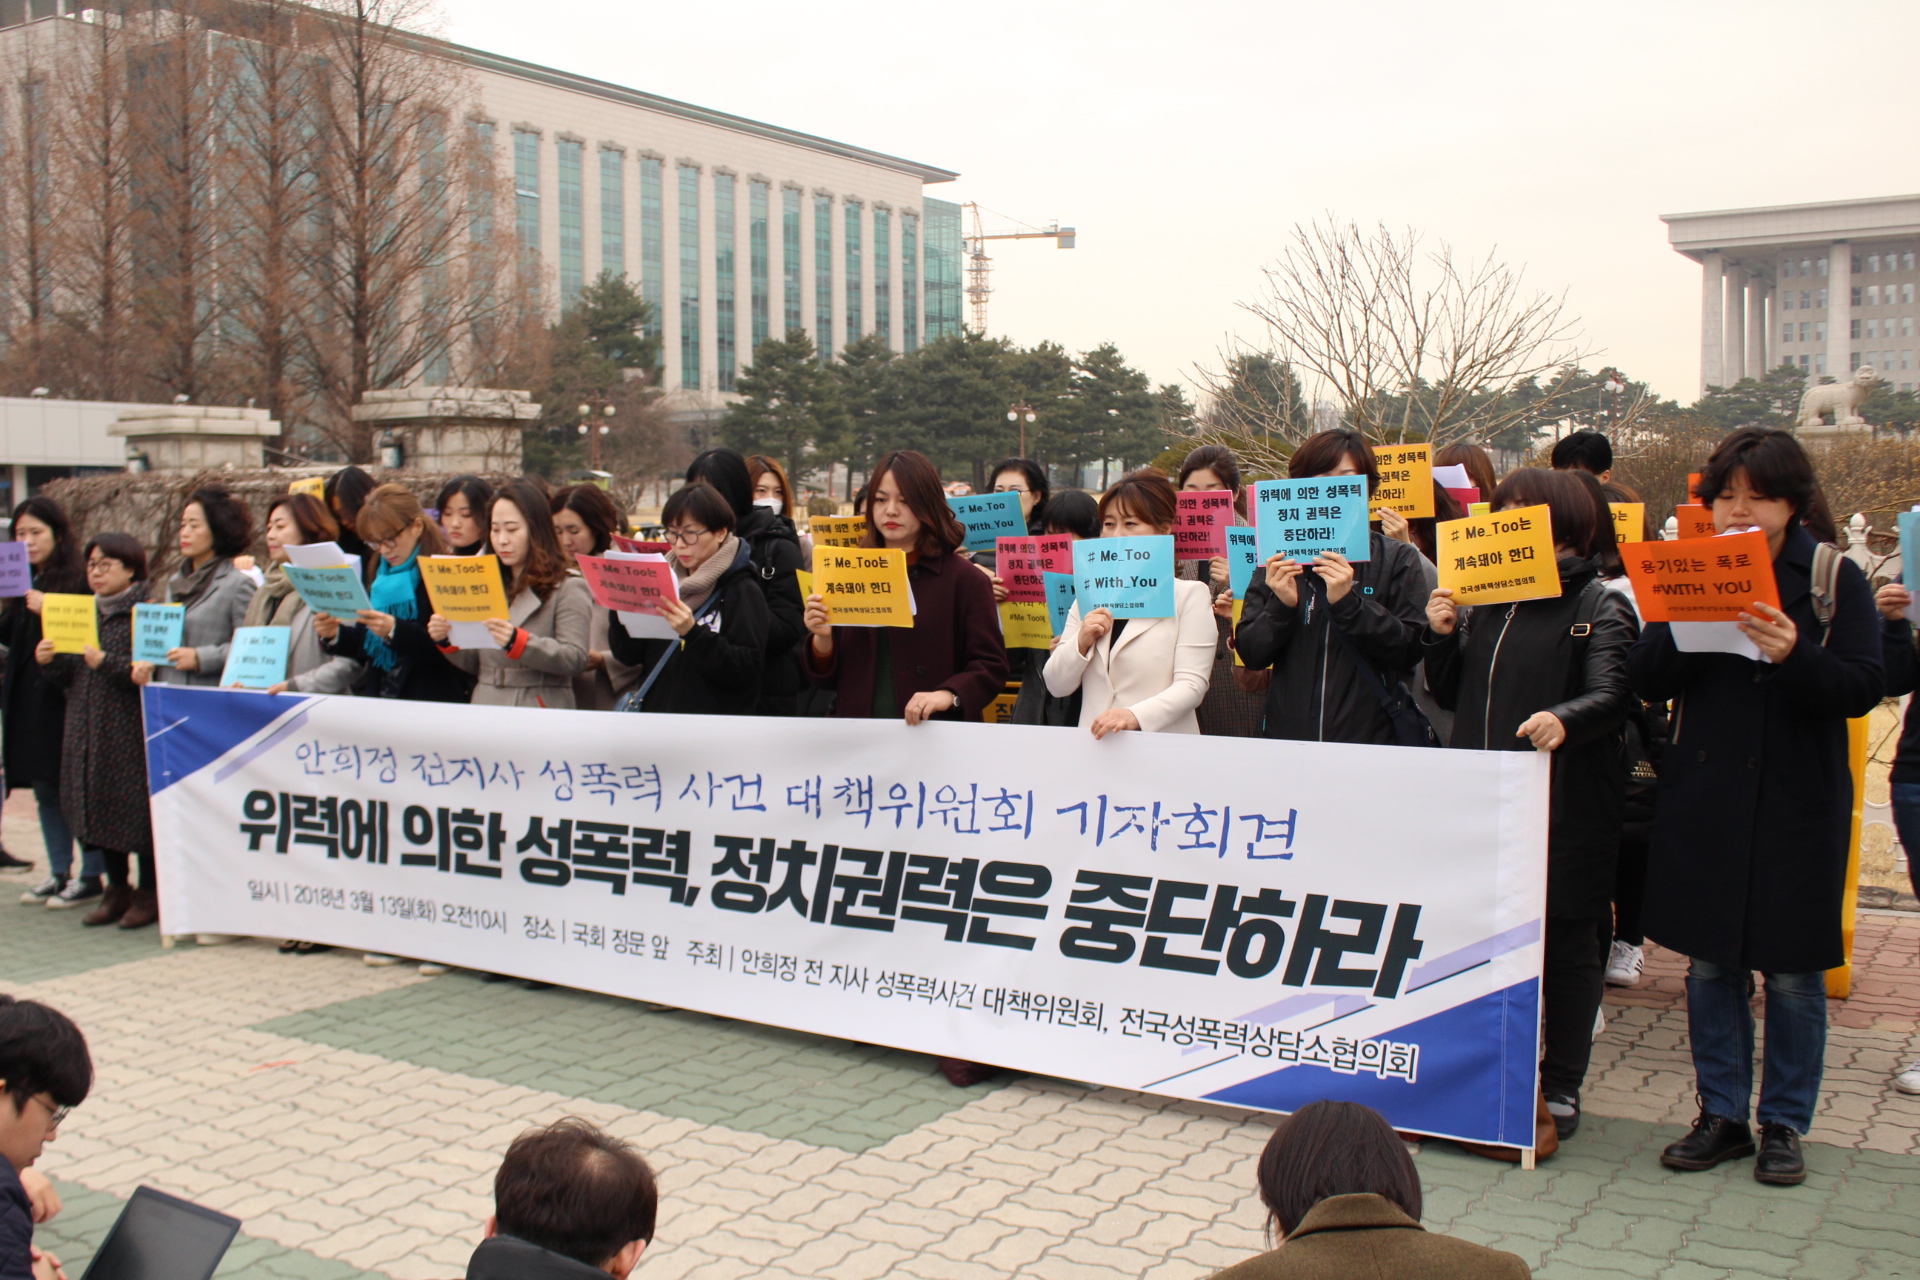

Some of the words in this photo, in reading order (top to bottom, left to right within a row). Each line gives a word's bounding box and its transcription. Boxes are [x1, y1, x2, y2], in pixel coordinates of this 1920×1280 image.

[1397, 451, 1426, 464] 성폭력
[1382, 470, 1410, 483] 권력은
[1260, 488, 1291, 502] 위력에
[1297, 487, 1319, 500] 의한
[1325, 484, 1361, 499] 성폭력
[1369, 488, 1405, 501] 단하라!
[968, 503, 1005, 513] Me_Too
[1179, 499, 1197, 509] 의한
[1202, 498, 1229, 509] 성폭력
[1187, 515, 1214, 526] 권력은
[1277, 508, 1299, 522] 정치
[1306, 506, 1342, 521] 권력은
[835, 523, 849, 533] 의한
[968, 520, 1014, 532] With_You
[1451, 530, 1460, 542] #
[1465, 517, 1531, 540] Me_Too는
[1230, 534, 1255, 546] 위력에
[1284, 527, 1335, 541] 중단하라!
[1040, 541, 1068, 553] 성폭력
[824, 557, 830, 567] #
[835, 556, 888, 568] Me_Too는
[1088, 551, 1095, 563] #
[1100, 549, 1150, 562] Me_Too
[1245, 552, 1257, 564] 정
[1454, 551, 1502, 571] 계속돼야
[1508, 546, 1534, 562] 한다
[1641, 558, 1706, 574] 용기있는
[1717, 554, 1752, 569] 폭로
[603, 564, 657, 578] Me_Too는
[826, 582, 865, 594] 계속돼야
[871, 582, 891, 594] 한다
[1084, 579, 1090, 590] #
[1095, 576, 1157, 589] With_You
[1460, 576, 1536, 594] 전국성폭력상담소협의회
[1652, 582, 1704, 596] #WITH
[1713, 580, 1752, 595] YOU
[641, 585, 661, 597] 한다
[295, 740, 397, 783] 안희정
[539, 760, 662, 813] 성폭력
[679, 771, 766, 812] 사건
[1056, 794, 1297, 860] 기자회견
[240, 790, 388, 864] 위력에
[401, 805, 506, 879] 의한
[516, 816, 701, 907] 성폭력,
[710, 835, 1052, 951] 정치권력은
[1059, 870, 1424, 999] 중단하라
[248, 880, 280, 903] 일시
[294, 885, 345, 908] 2018년
[351, 890, 373, 913] 3월
[380, 896, 436, 923] 13일(화)
[442, 904, 508, 934] 오전10시
[523, 915, 556, 939] 장소
[572, 922, 605, 949] 국회
[612, 929, 646, 956] 정문
[651, 935, 669, 960] 앞
[686, 941, 722, 969] 주최
[741, 949, 798, 982] 안희정
[804, 959, 823, 986] 전
[829, 964, 869, 994] 지사
[876, 970, 977, 1010] 성폭력사건
[983, 988, 1108, 1034] 대책위원회,
[1120, 1007, 1417, 1080] 전국성폭력상담소협의회
